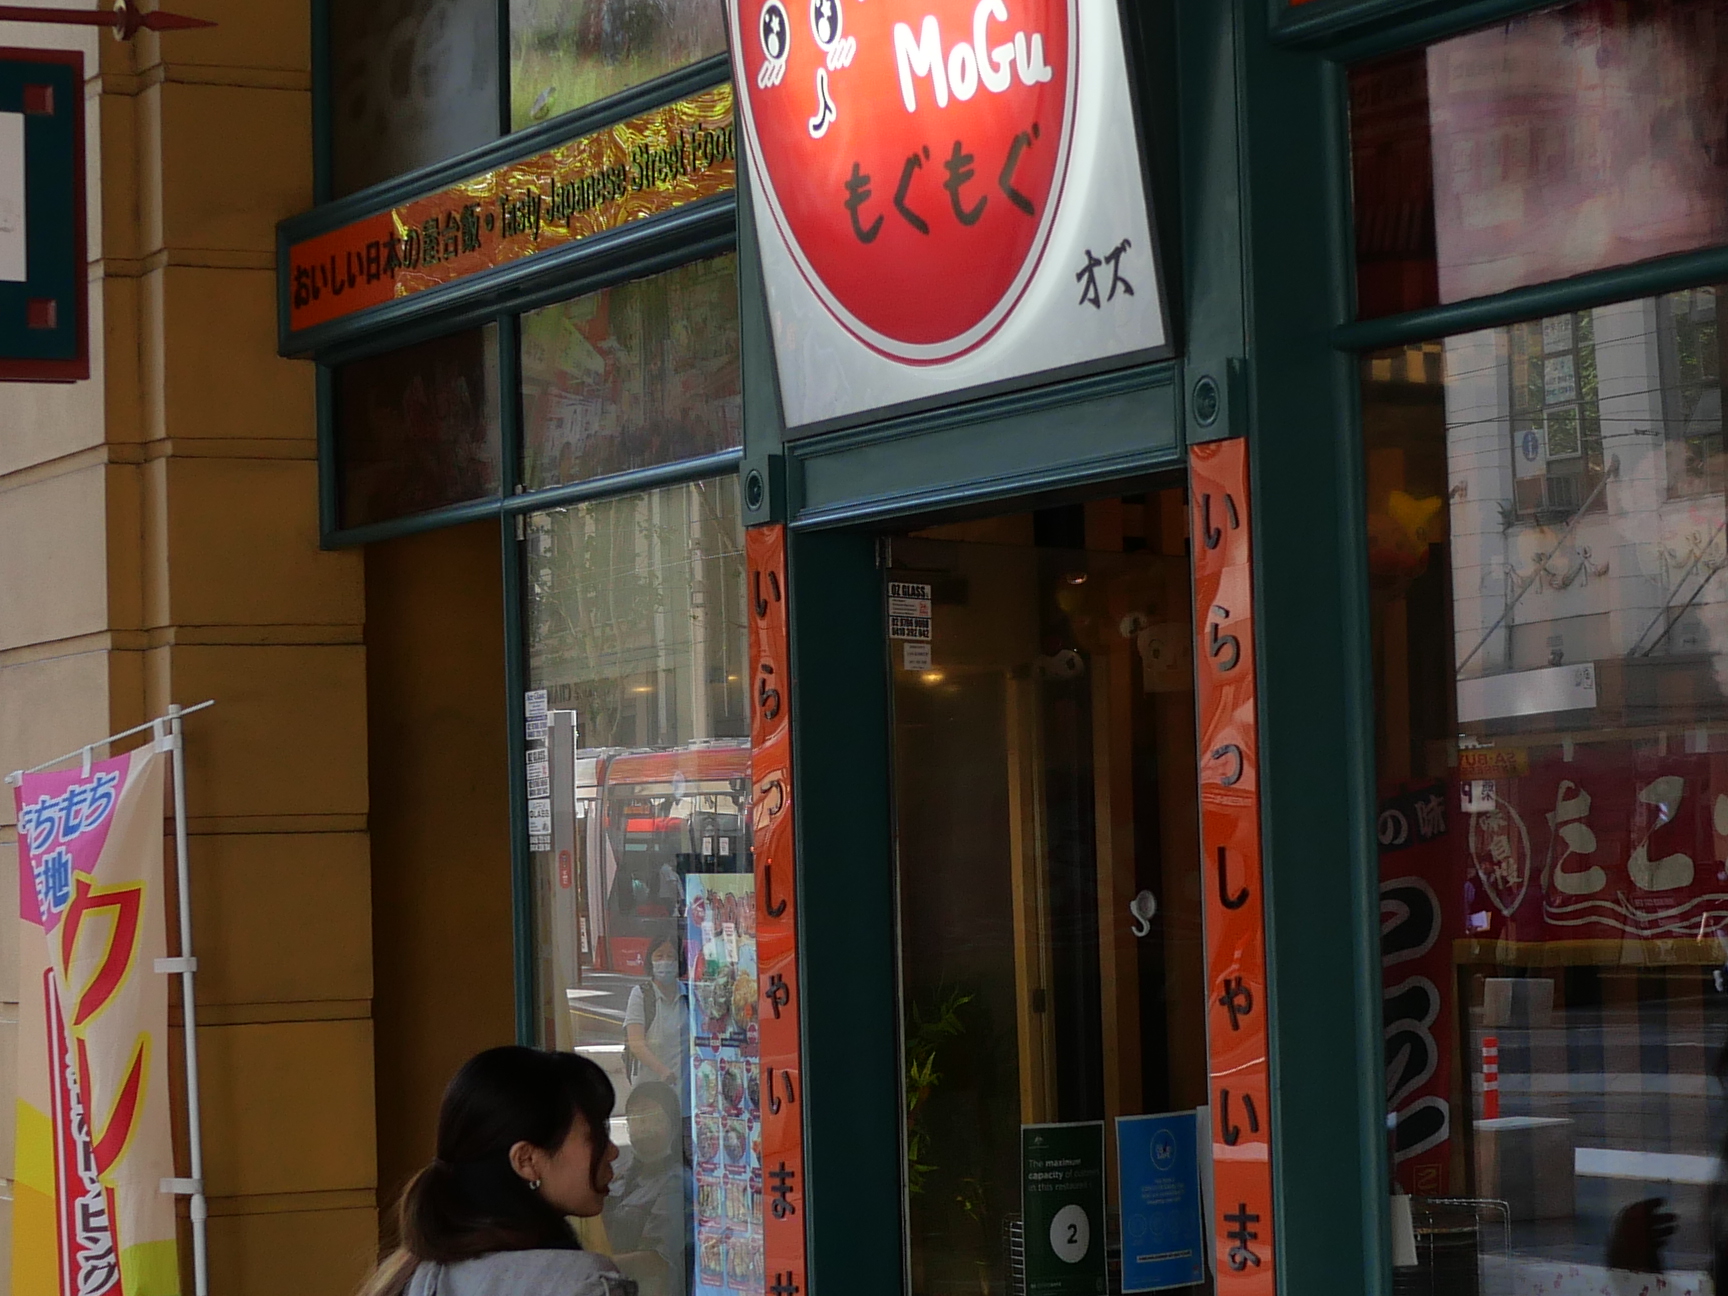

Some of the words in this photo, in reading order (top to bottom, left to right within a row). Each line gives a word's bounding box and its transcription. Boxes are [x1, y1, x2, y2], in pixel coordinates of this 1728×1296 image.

[500, 188, 541, 241] Tasty
[546, 163, 627, 228] Japanese
[631, 131, 687, 192] Street
[843, 124, 1041, 245] もぐもぐ
[902, 585, 926, 597] GLASS
[1028, 1159, 1044, 1169] The
[1028, 1170, 1064, 1181] capacity
[1067, 1223, 1078, 1244] 2
